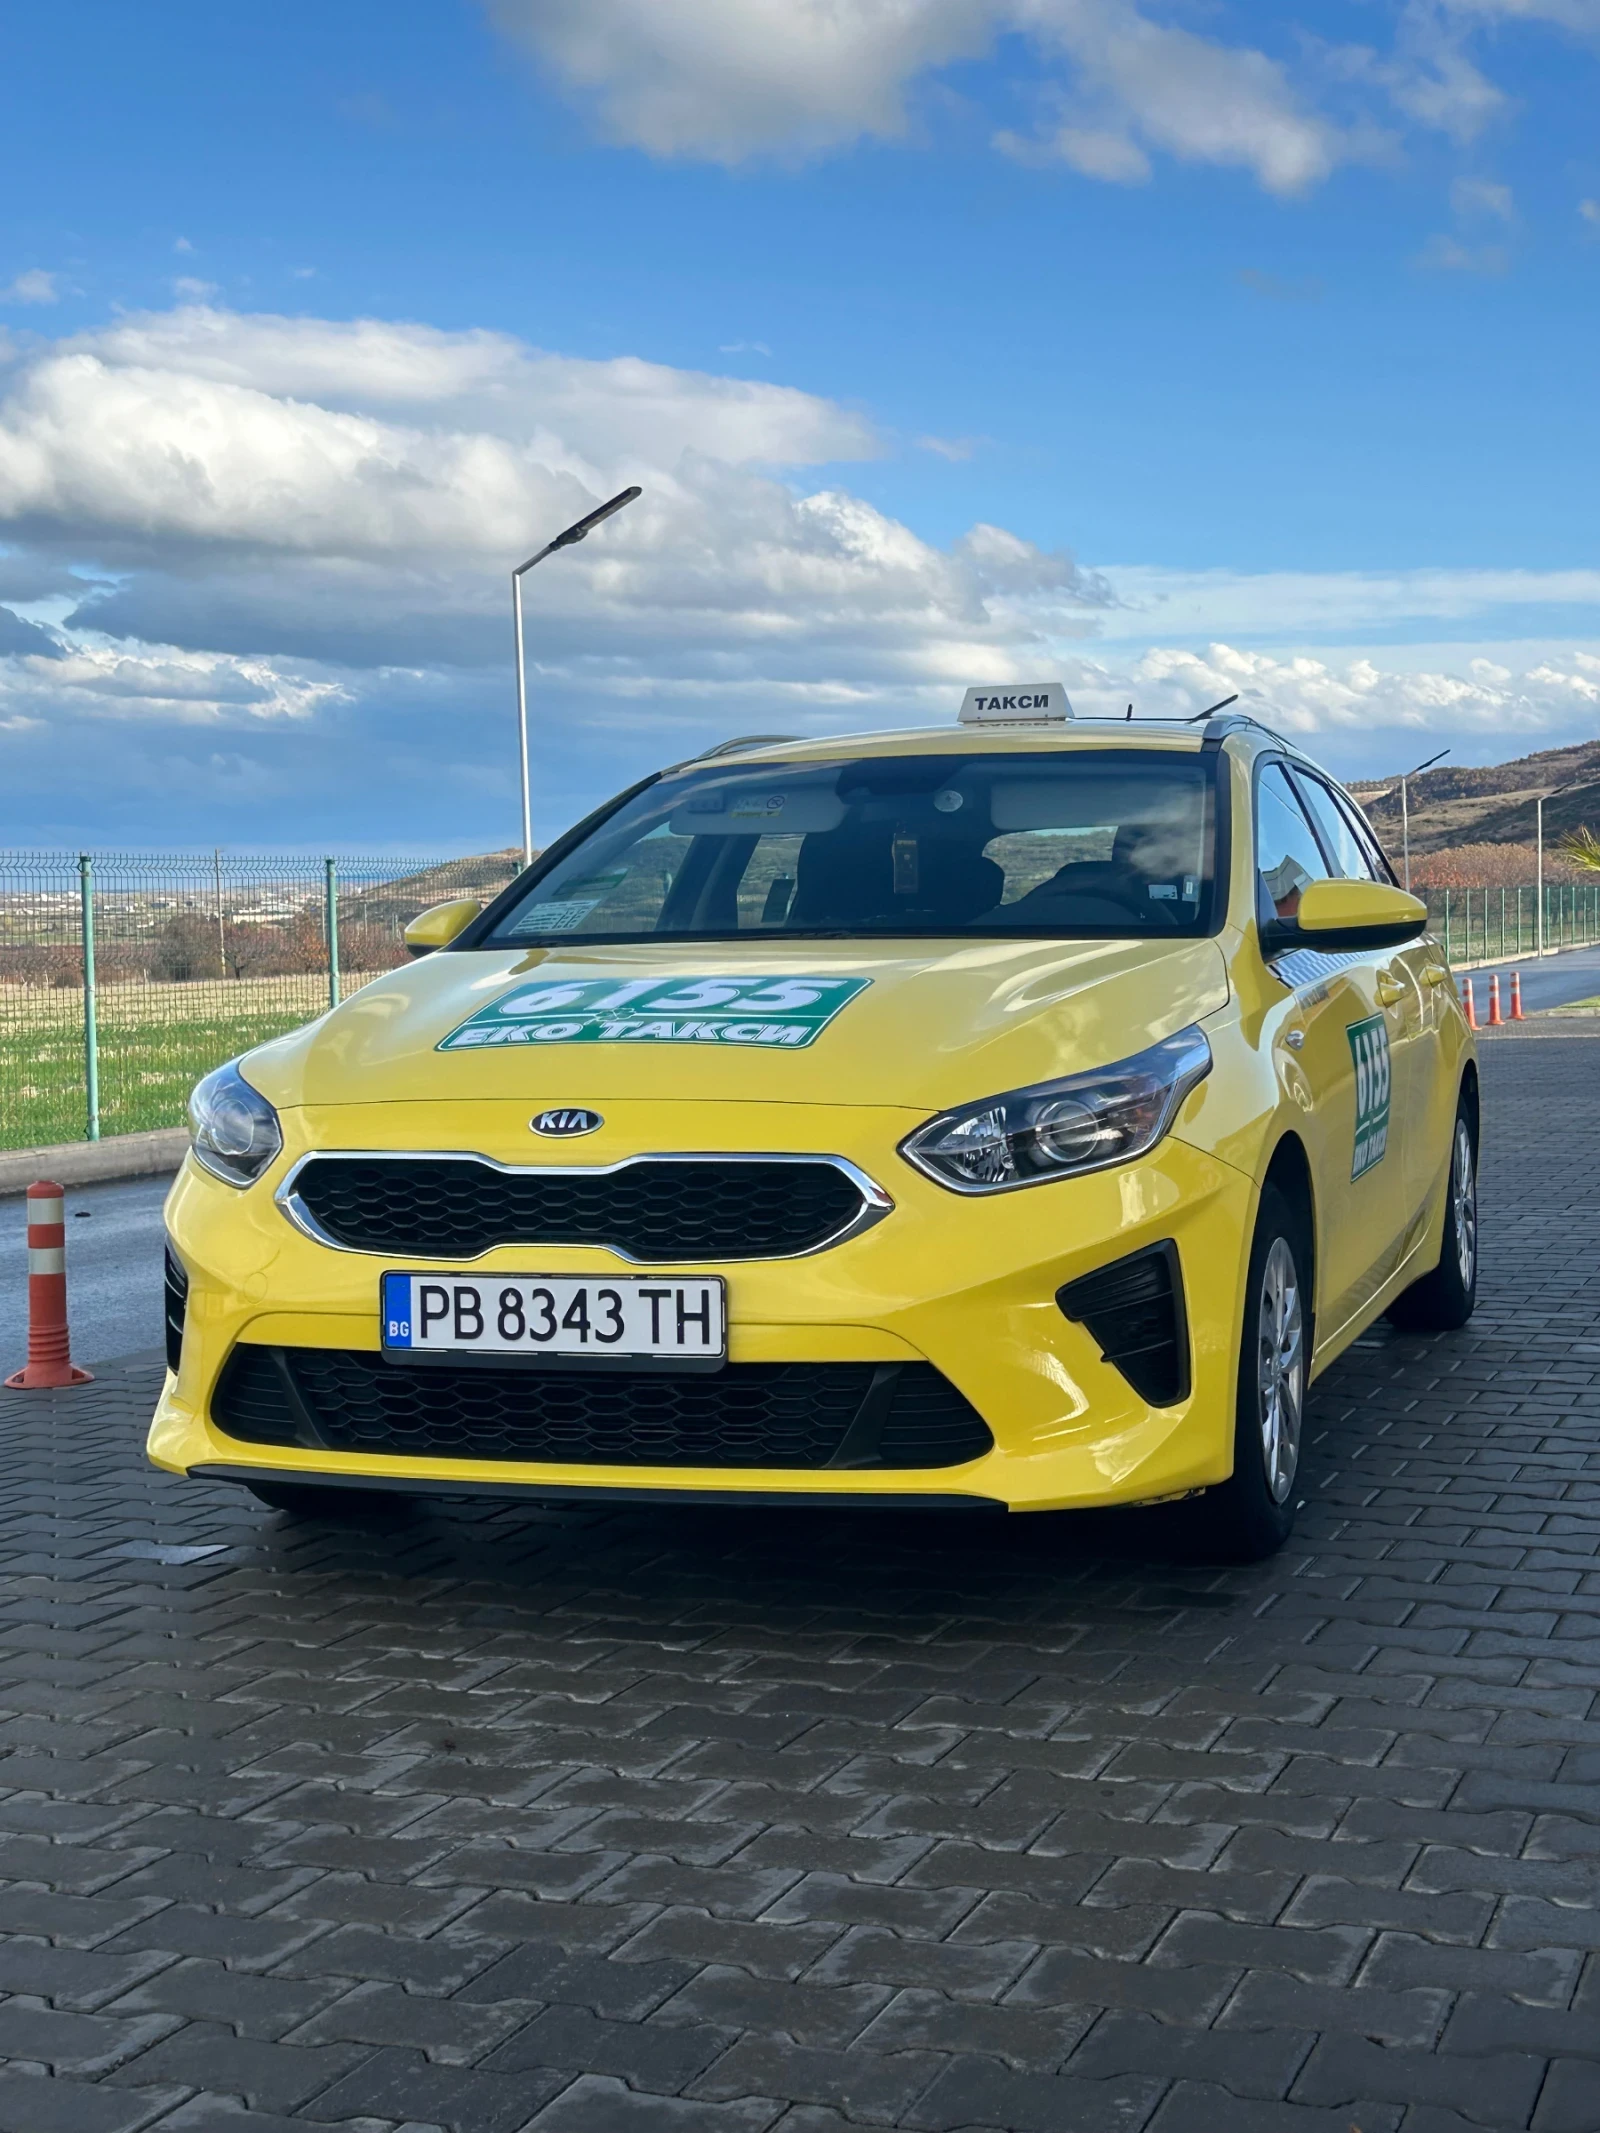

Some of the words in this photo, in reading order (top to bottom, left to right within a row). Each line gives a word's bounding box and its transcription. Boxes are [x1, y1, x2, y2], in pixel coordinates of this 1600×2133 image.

[974, 694, 1049, 711] ТАКСИ
[499, 978, 848, 1014] 6155
[450, 1022, 585, 1047] ЕКО
[598, 1020, 812, 1045] ТАКСИ
[1354, 1024, 1391, 1119] 6155
[539, 1111, 588, 1130] KIA
[419, 1285, 485, 1340] PB
[497, 1287, 625, 1344] 8343
[638, 1288, 710, 1345] TH
[388, 1320, 410, 1338] BG
